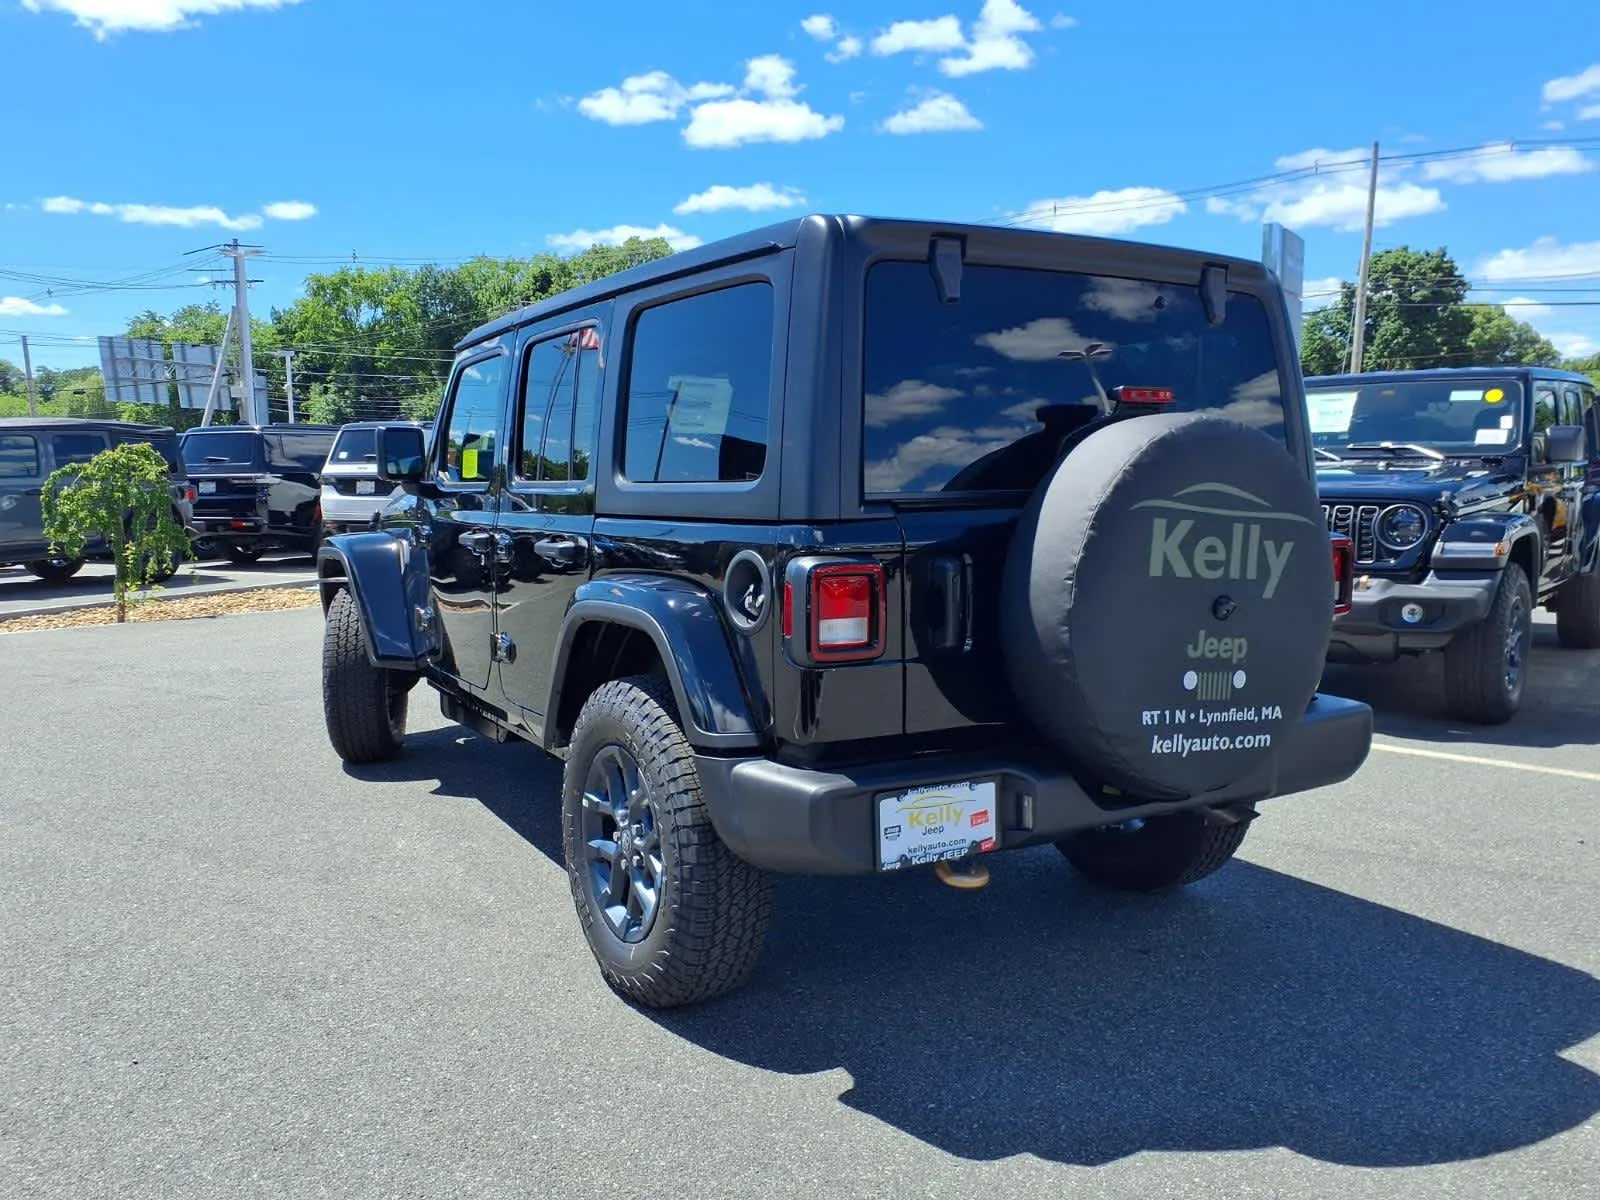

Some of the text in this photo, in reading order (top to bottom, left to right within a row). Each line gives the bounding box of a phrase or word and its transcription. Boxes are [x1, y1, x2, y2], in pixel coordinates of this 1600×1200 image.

[1149, 517, 1295, 599] Kelly
[1187, 630, 1248, 664] Jeep
[1142, 705, 1283, 727] RT 1 N Lynnfield, MA
[1151, 733, 1271, 758] kellyauto.com
[908, 804, 965, 829] Kelly
[922, 825, 945, 836] Jeep
[907, 838, 967, 855] kellyauto.com
[941, 847, 968, 860] JEEP
